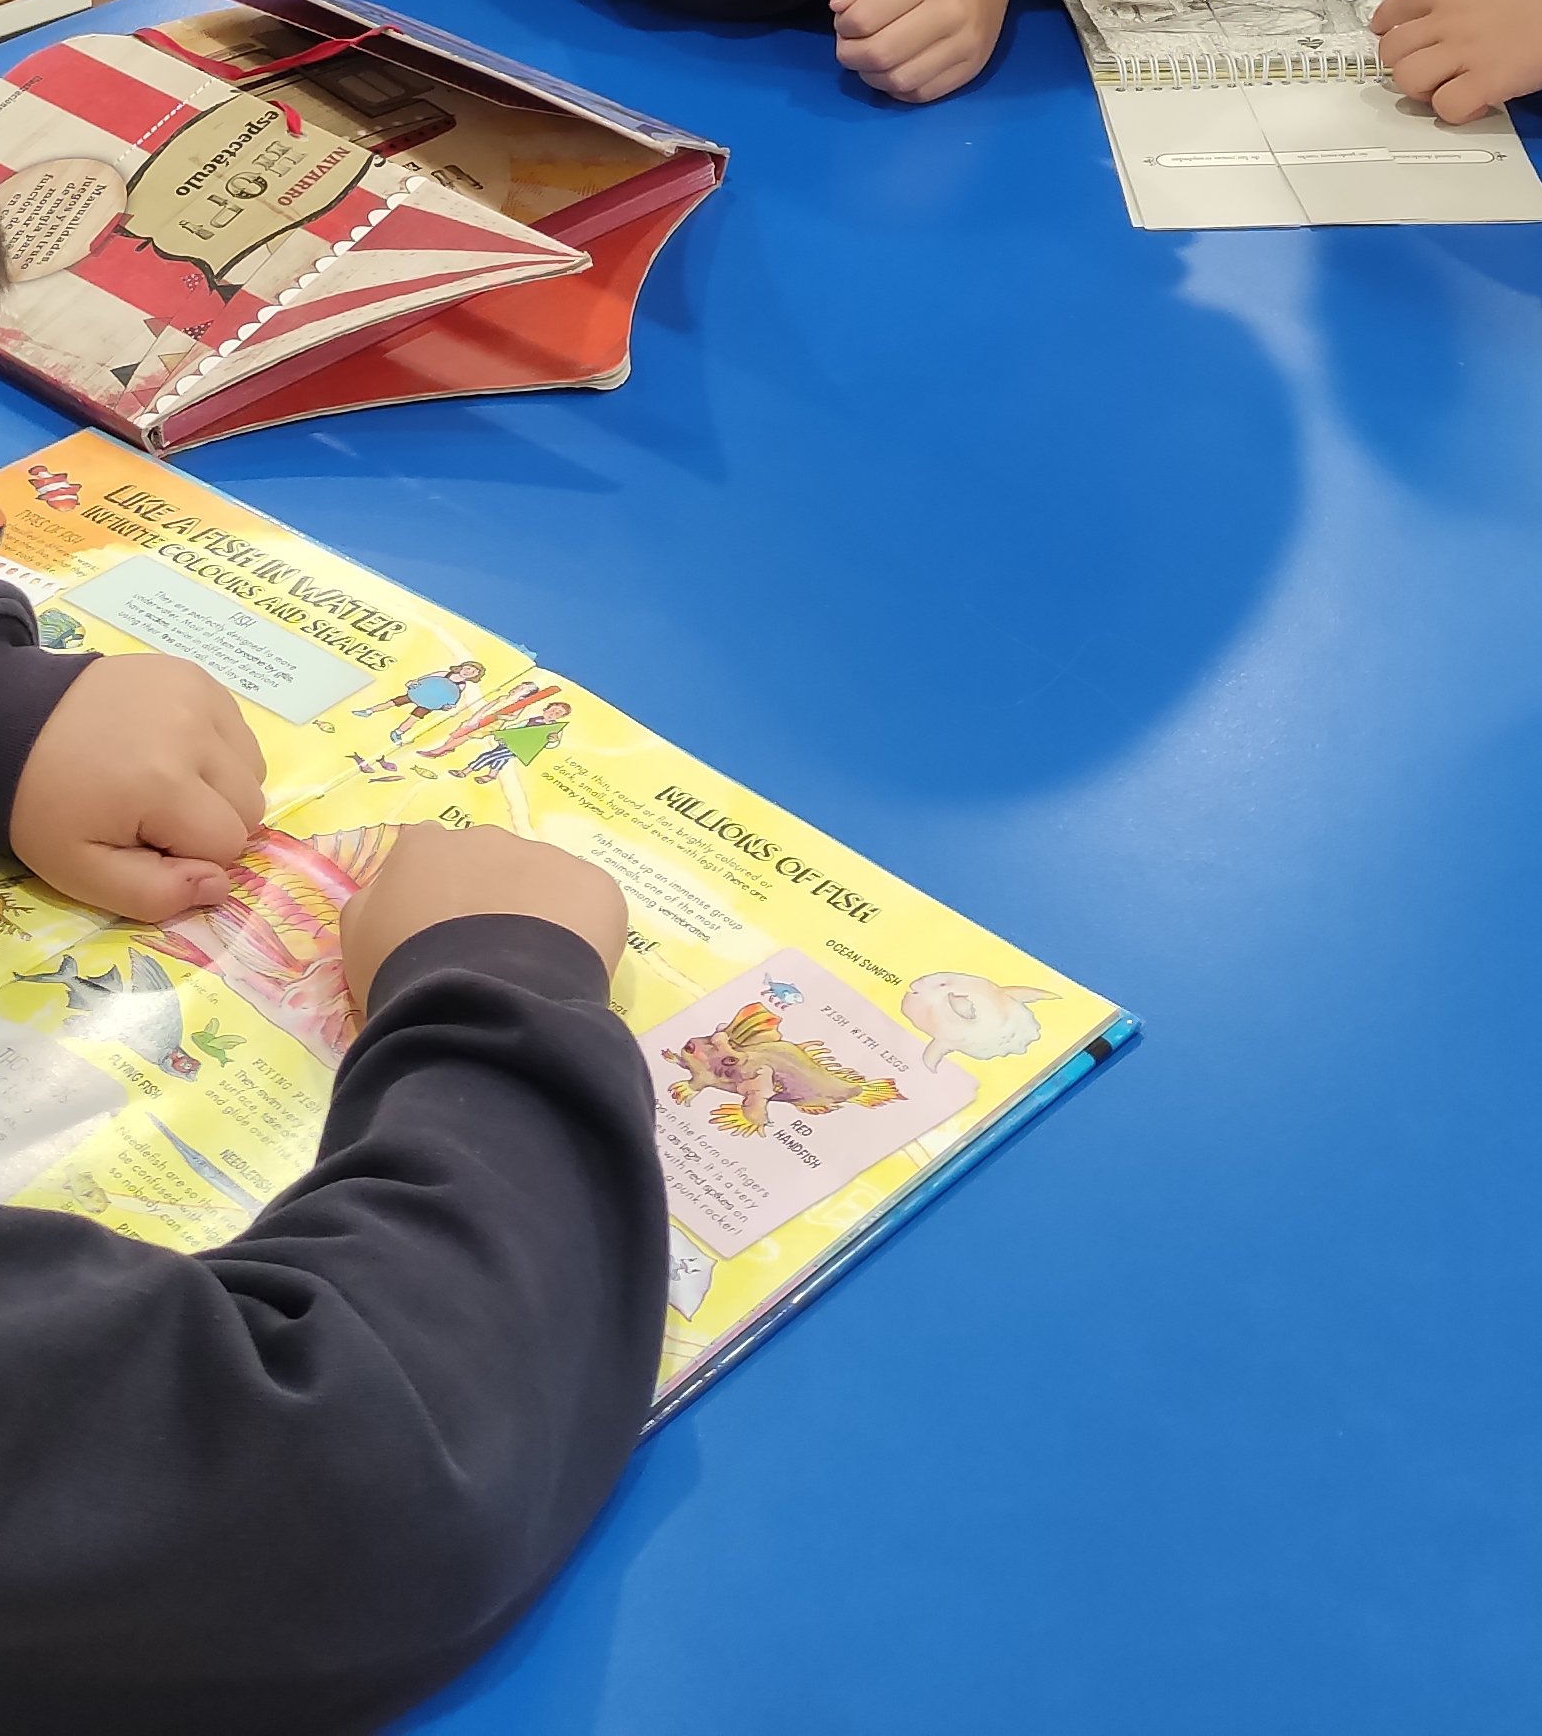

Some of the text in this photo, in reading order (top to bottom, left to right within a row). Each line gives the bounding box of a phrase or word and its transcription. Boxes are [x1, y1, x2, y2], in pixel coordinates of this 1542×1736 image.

[173, 106, 282, 202] espectáculo
[277, 146, 351, 206] NAVARRO
[4, 173, 54, 230] función de
[32, 182, 76, 233] de magia
[36, 184, 108, 265] Manualidades,
[80, 504, 399, 672] INFINITE COLOURS AND SHAPES
[103, 483, 408, 642] LIKE A FISH IN WATER
[228, 611, 257, 629] FISH
[552, 764, 768, 902] dark, small, huge and even with legs! There are
[564, 756, 773, 889] Long, thin, round or flat, brightly coloured or
[654, 785, 881, 924] MILLIONS OF FISH
[590, 849, 722, 931] of animals, one of the most
[592, 833, 743, 930] Fish make up an immense group
[825, 939, 903, 986] OCEAN SUNFISH
[820, 1005, 910, 1073] FISH WITH LEGS
[139, 1079, 164, 1101] FISH
[251, 1058, 323, 1112] FLYING FISH
[772, 1129, 821, 1169] HANDFISH
[789, 1119, 813, 1137] RED
[218, 1148, 275, 1195] NEEDLEFISH
